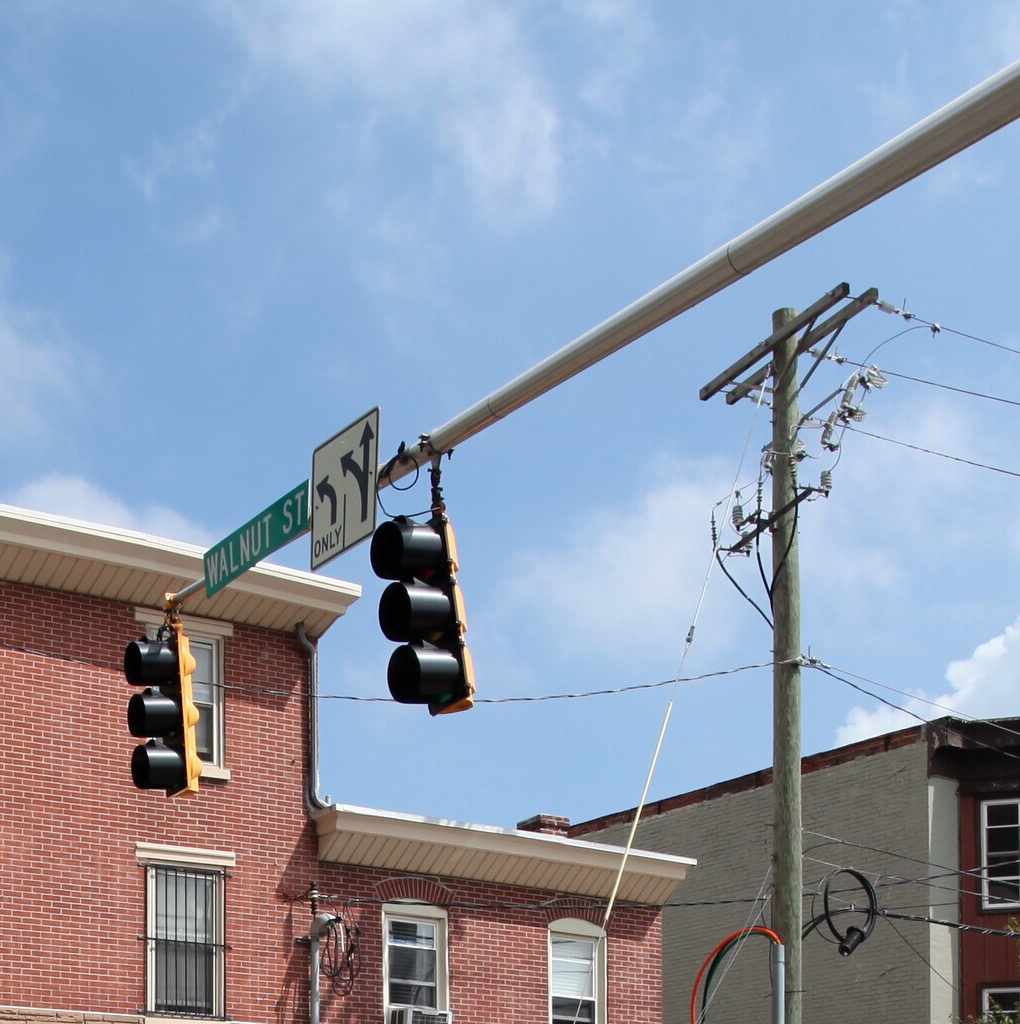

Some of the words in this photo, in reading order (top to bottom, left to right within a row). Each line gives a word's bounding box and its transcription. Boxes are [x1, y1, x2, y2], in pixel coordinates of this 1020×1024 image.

[207, 513, 272, 588] WALNUT
[282, 489, 305, 535] ST
[313, 525, 343, 559] ONLY
